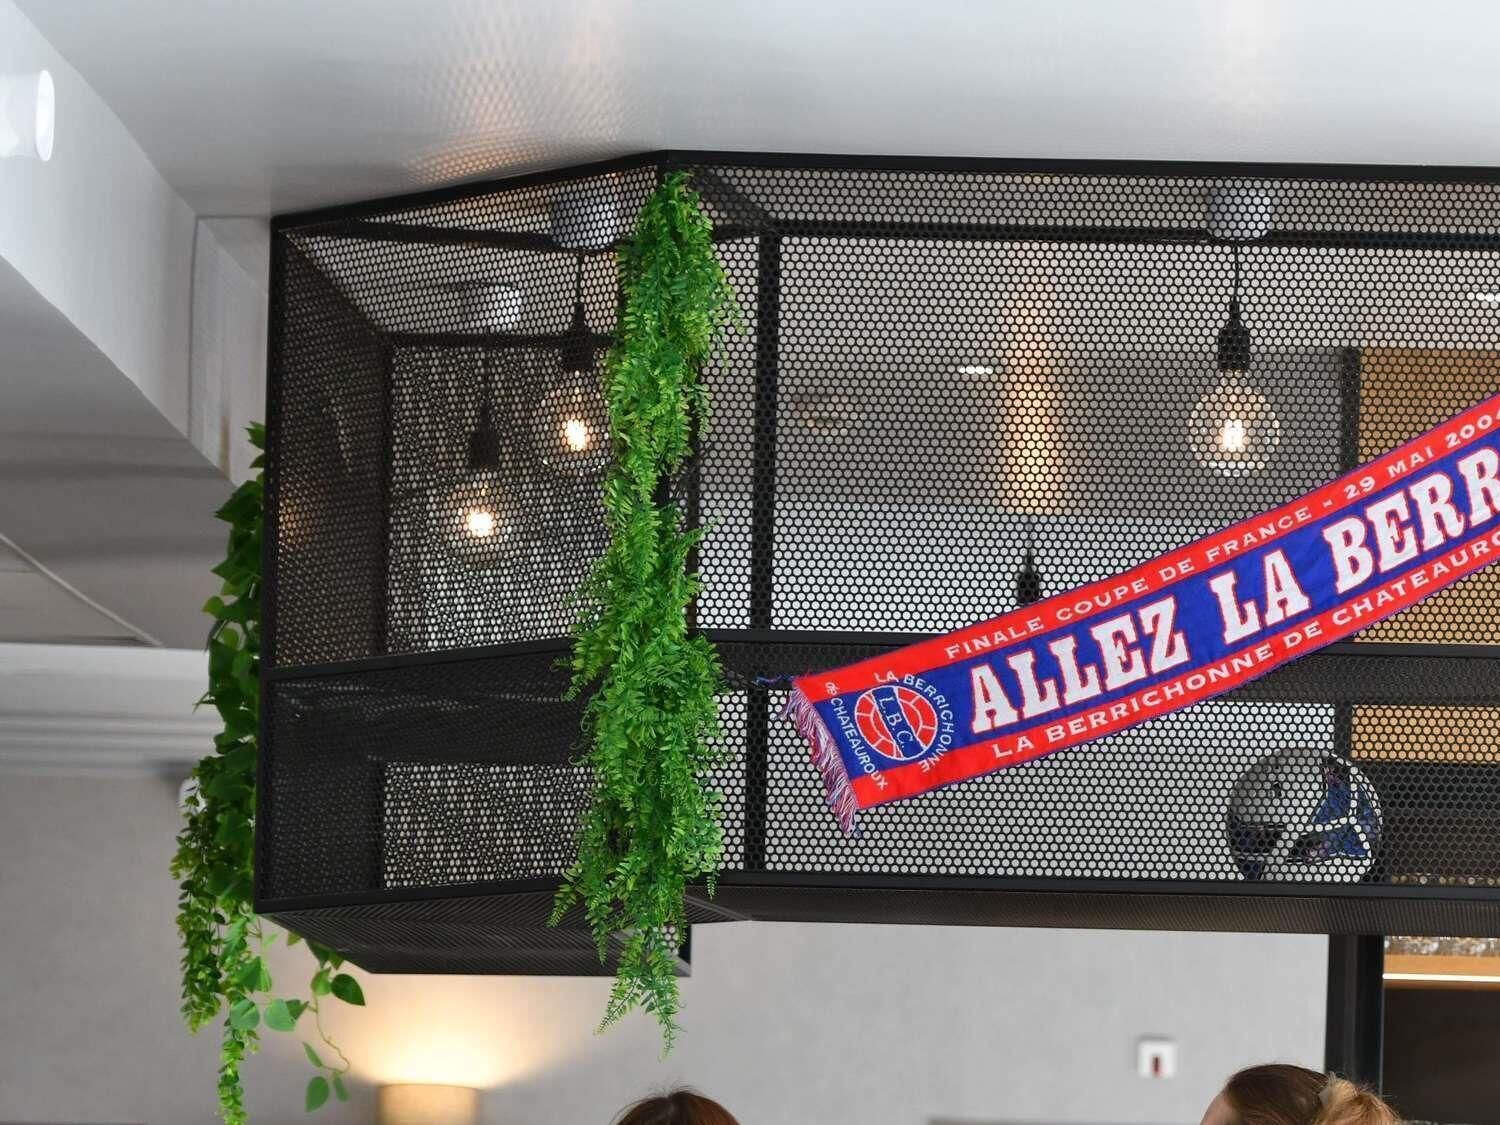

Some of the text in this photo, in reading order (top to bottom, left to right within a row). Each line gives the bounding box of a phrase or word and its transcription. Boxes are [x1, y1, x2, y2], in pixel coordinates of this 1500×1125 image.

[944, 617, 1045, 659] FINALE
[1056, 578, 1149, 621] COUPE
[1158, 559, 1195, 582] DE
[1205, 506, 1312, 562] FRANCE
[1344, 476, 1376, 500] 29
[1387, 447, 1435, 478] MAI
[969, 595, 1190, 734] ALLEZ
[1208, 549, 1312, 645] LA
[992, 736, 1034, 759] LA
[1046, 643, 1274, 743] BERRICHONNE
[1283, 620, 1323, 648] DE
[830, 697, 888, 790] CHATEAUROUX
[873, 670, 955, 773] LA BERRICHONNE
